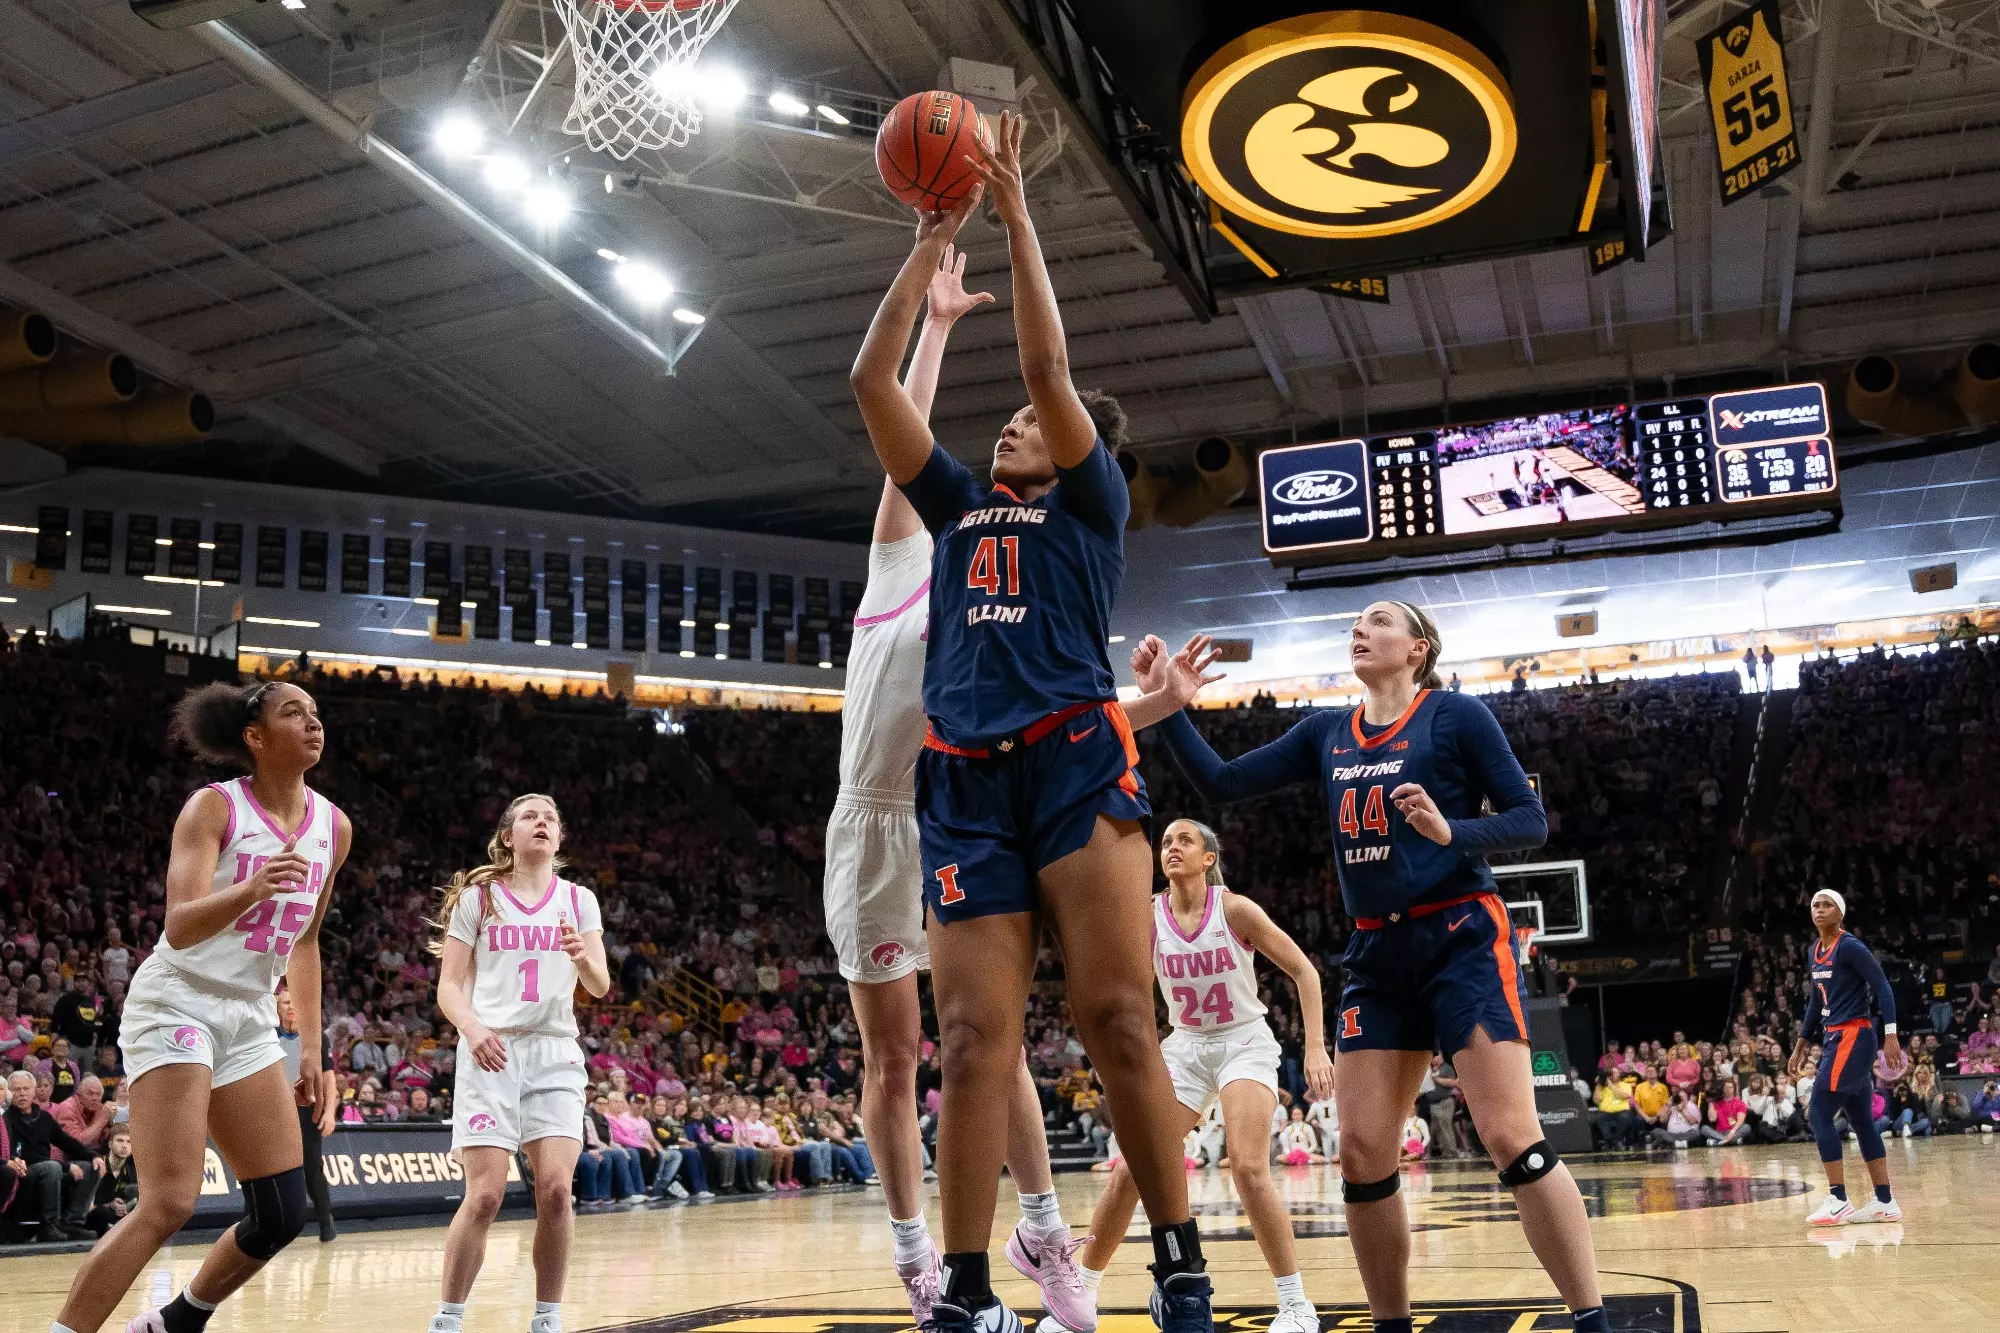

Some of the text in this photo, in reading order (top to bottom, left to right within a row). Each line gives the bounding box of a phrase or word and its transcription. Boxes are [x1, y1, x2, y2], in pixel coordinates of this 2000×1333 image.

[1727, 60, 1762, 87] GARZA
[1723, 74, 1781, 147] 55
[1725, 141, 1795, 196] 2018-21
[1664, 404, 1680, 415] ILL
[1668, 419, 1684, 432] PTS
[1690, 418, 1701, 429] FL
[1388, 437, 1415, 448] IOWA
[1652, 432, 1703, 449] 1 7 1
[1397, 452, 1413, 464] PTS
[1419, 451, 1430, 462] FL
[1653, 447, 1705, 464] 5 0 0
[1382, 465, 1430, 481] 1 4 1
[1650, 461, 1706, 479] 24 5 1
[1727, 455, 1826, 481] 35 7:53 20
[1287, 475, 1342, 501] Ford
[1378, 480, 1432, 496] 20 8 0
[1653, 476, 1708, 492] 41 0 1
[1380, 493, 1433, 510] 22 9 0
[1654, 491, 1710, 508] 44 2 1
[1272, 506, 1361, 525] BuyFordNow.com
[1380, 507, 1433, 525] 24 0 1
[1381, 522, 1435, 538] 45 6 0
[967, 536, 1019, 595] 41
[967, 604, 1027, 626] ILLINI
[1646, 637, 1715, 659] IOWA
[1332, 760, 1404, 781] FIGHTING
[1339, 785, 1389, 838] 44
[1345, 845, 1391, 864] ILLINI
[935, 863, 965, 906] I
[235, 899, 313, 956] 45
[1160, 946, 1237, 979] IOWA
[519, 959, 540, 1002] 1
[1171, 982, 1234, 1026] 24
[1342, 1005, 1362, 1038] I
[360, 1152, 464, 1185] SCREENS
